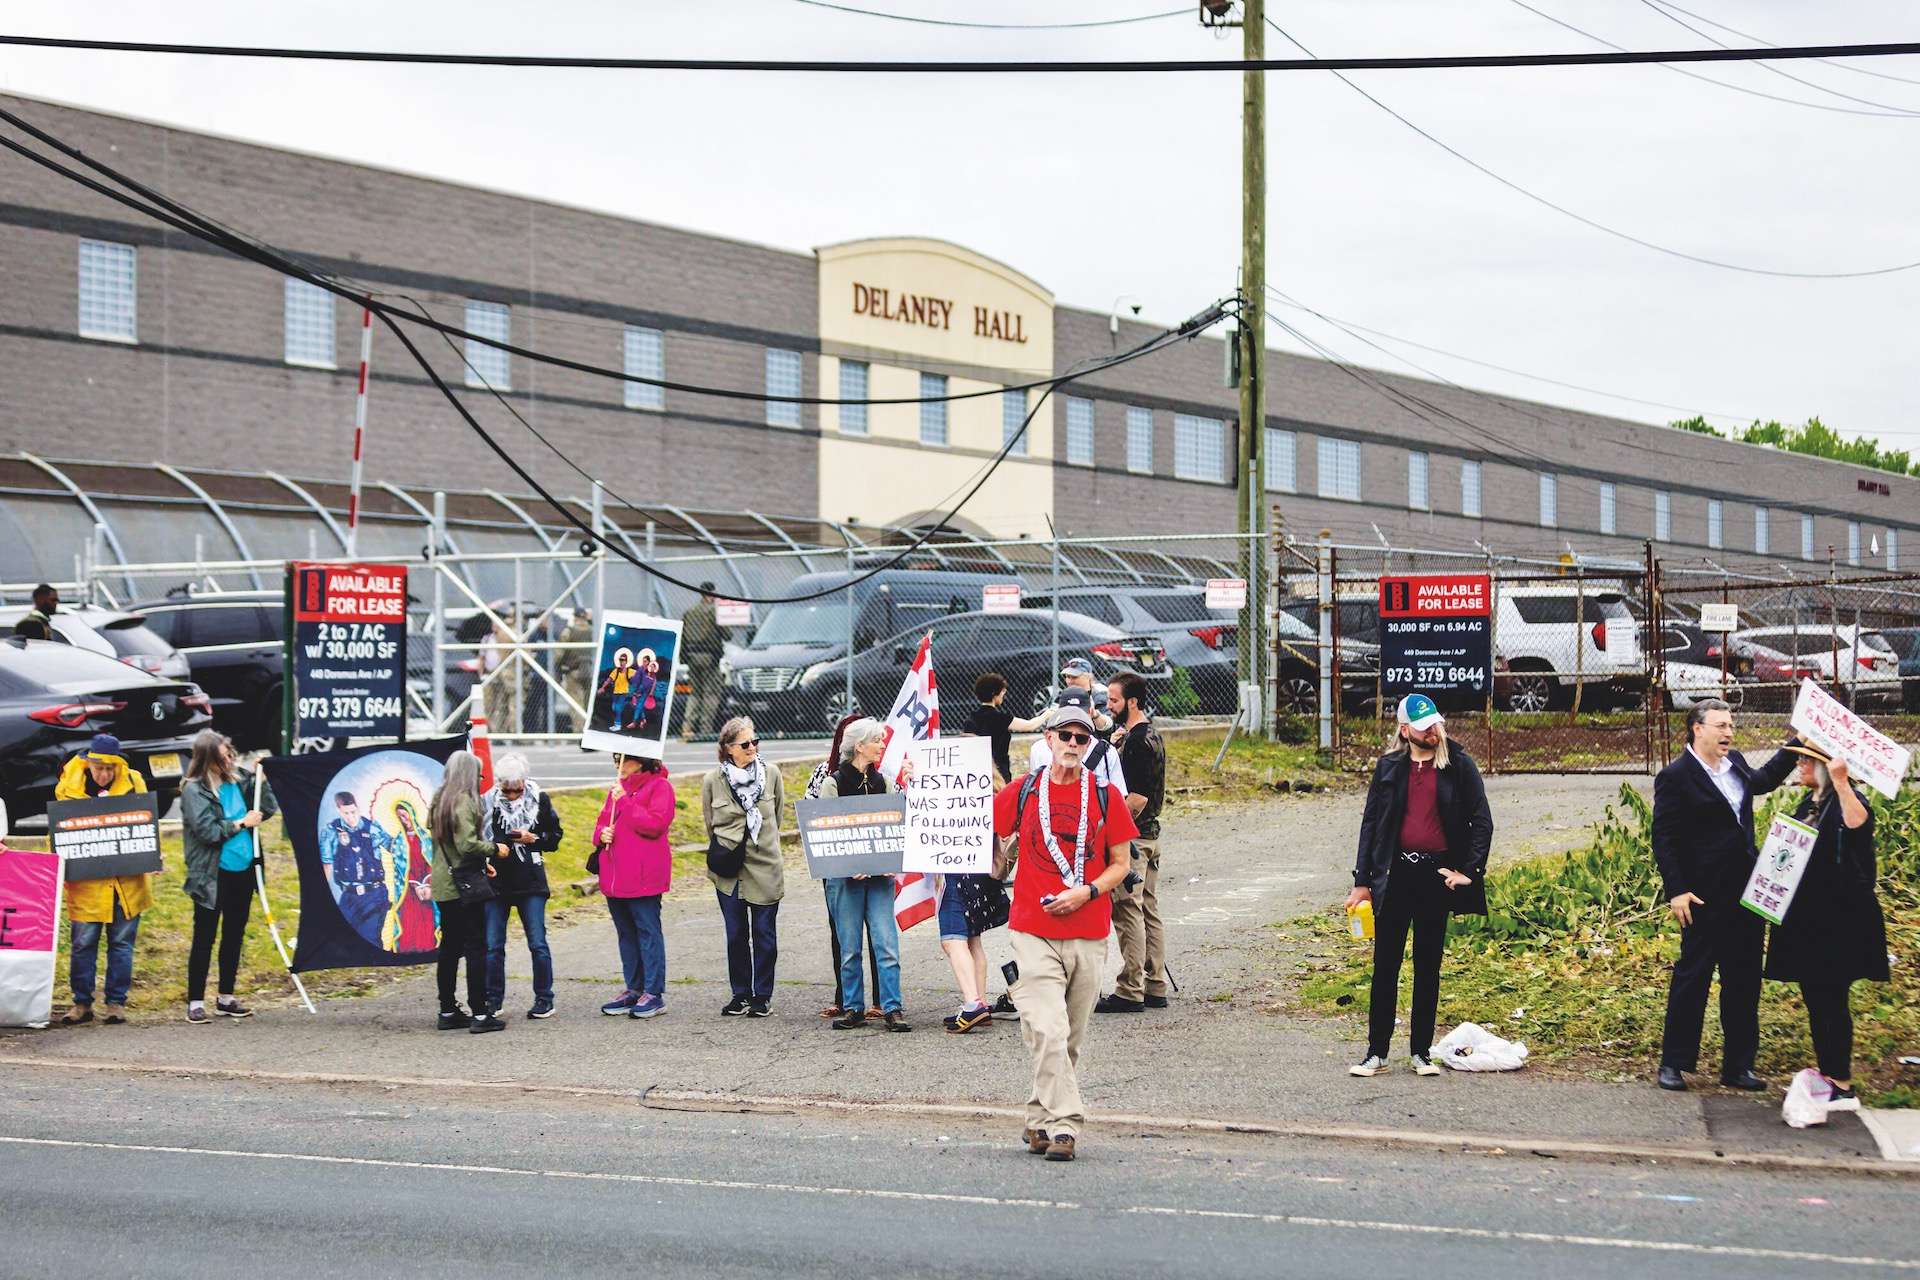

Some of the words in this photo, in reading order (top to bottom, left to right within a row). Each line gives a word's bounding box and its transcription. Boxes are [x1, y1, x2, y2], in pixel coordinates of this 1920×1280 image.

[853, 281, 953, 331] DELANEY
[974, 305, 1028, 344] HALL
[329, 575, 403, 594] AVAILABLE
[1418, 584, 1483, 597] AVAILABLE
[328, 596, 357, 614] FOR
[359, 598, 403, 616] LEASE
[1417, 598, 1442, 610] FOR
[1445, 597, 1484, 610] LEASE
[318, 622, 329, 641] 2
[331, 624, 348, 641] to
[350, 624, 360, 641] 7
[361, 623, 386, 641] AC
[1387, 622, 1417, 634] 30,000
[1419, 622, 1431, 632] SF
[1433, 624, 1445, 632] on
[1447, 622, 1467, 632] 6.94
[1468, 621, 1482, 631] AC
[305, 641, 324, 659] w/
[325, 641, 375, 661] 30,000
[377, 641, 398, 659] SF
[358, 669, 372, 680] Ave
[1386, 667, 1413, 682] 973
[1417, 667, 1444, 682] 379
[1448, 666, 1485, 682] 6644
[299, 697, 329, 719] 973
[331, 697, 361, 719] 379
[364, 696, 402, 718] 6644
[920, 745, 964, 769] THE
[909, 796, 939, 812] WAS
[946, 795, 992, 810] JUST
[911, 814, 992, 830] FOLLOWING
[54, 826, 131, 846] IMMIGRANTS
[131, 824, 157, 839] ARE
[806, 826, 883, 844] IMMIGRANTS
[919, 832, 983, 847] ORDERS
[55, 840, 119, 860] WELCOME
[119, 837, 157, 855] HERE!
[809, 840, 873, 858] WELCOME
